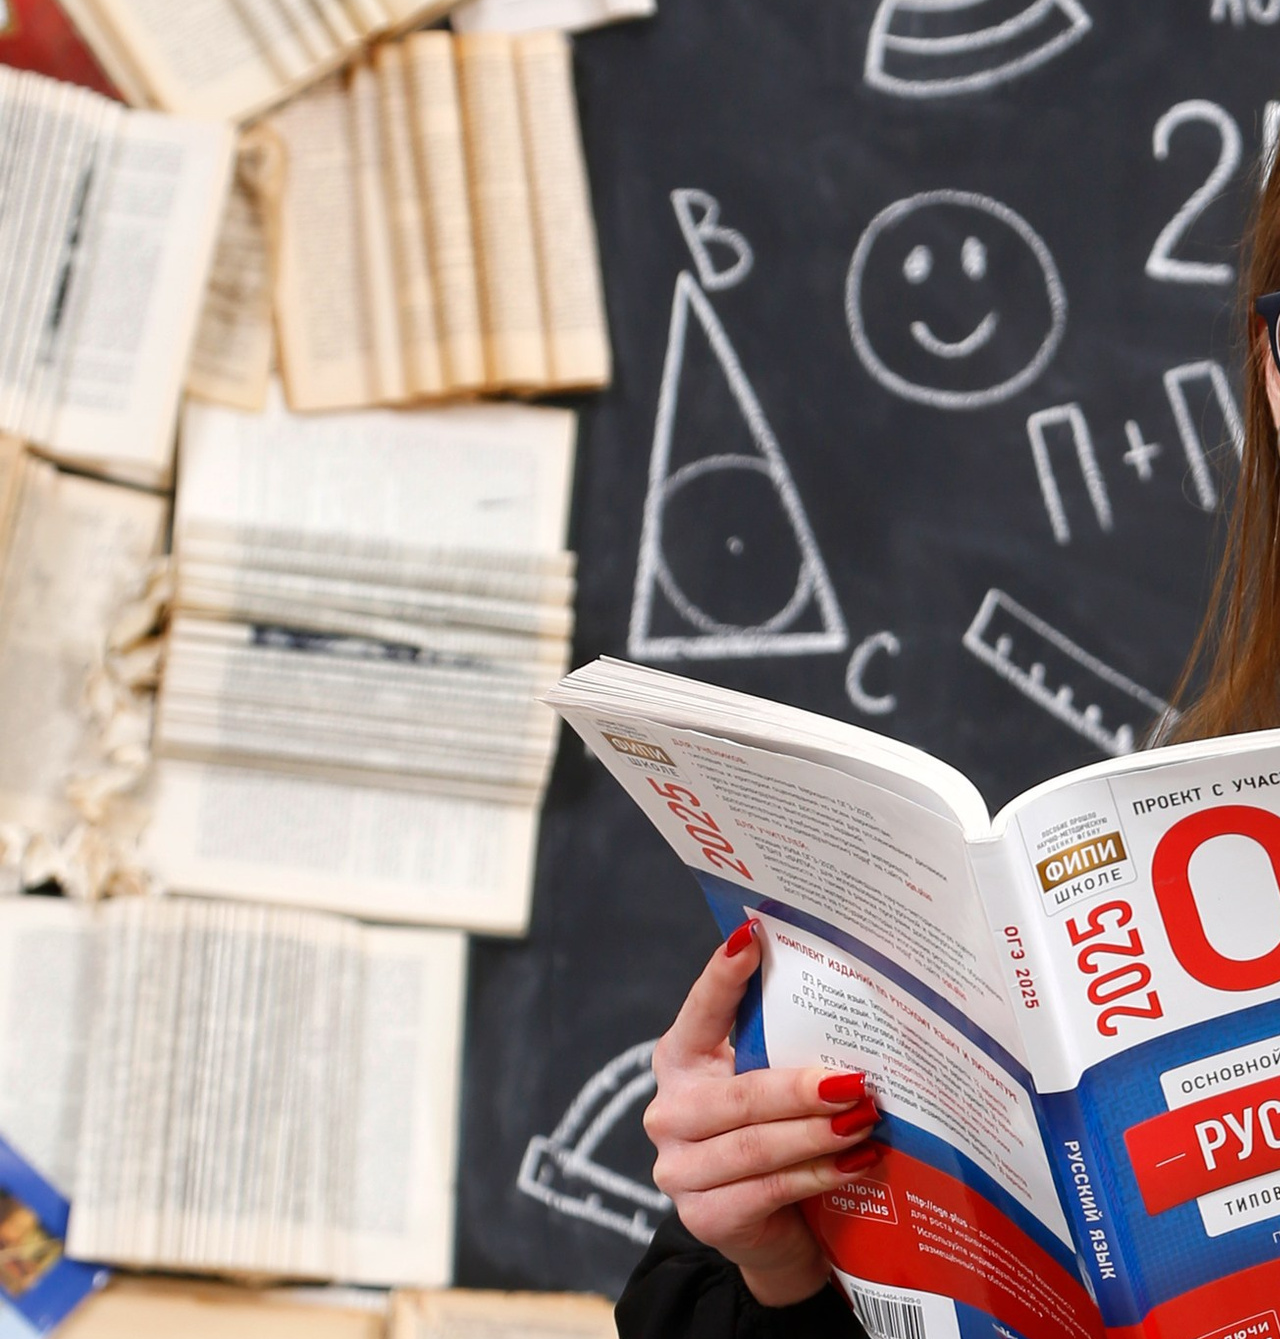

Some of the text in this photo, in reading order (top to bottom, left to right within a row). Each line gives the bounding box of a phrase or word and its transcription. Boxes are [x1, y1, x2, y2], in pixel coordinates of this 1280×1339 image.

[611, 737, 668, 764] ФИПИ
[627, 756, 681, 778] ШКОЛЕ
[1132, 787, 1202, 816] ПРОЕКТ
[1211, 783, 1225, 797] С
[645, 776, 755, 882] 2025
[1045, 838, 1118, 882] ФИПИ
[1053, 867, 1123, 905] ШКОЛЕ
[775, 932, 825, 964] КОМПЛЕКТ
[827, 957, 875, 989] ИЗДАНИЙ
[1004, 926, 1040, 1010] ОГЭ 2025
[1065, 899, 1165, 1038] 2025
[831, 1195, 889, 1216] oge.plus
[1064, 1139, 1117, 1280] РУССКИЙ ЯЗЫК
